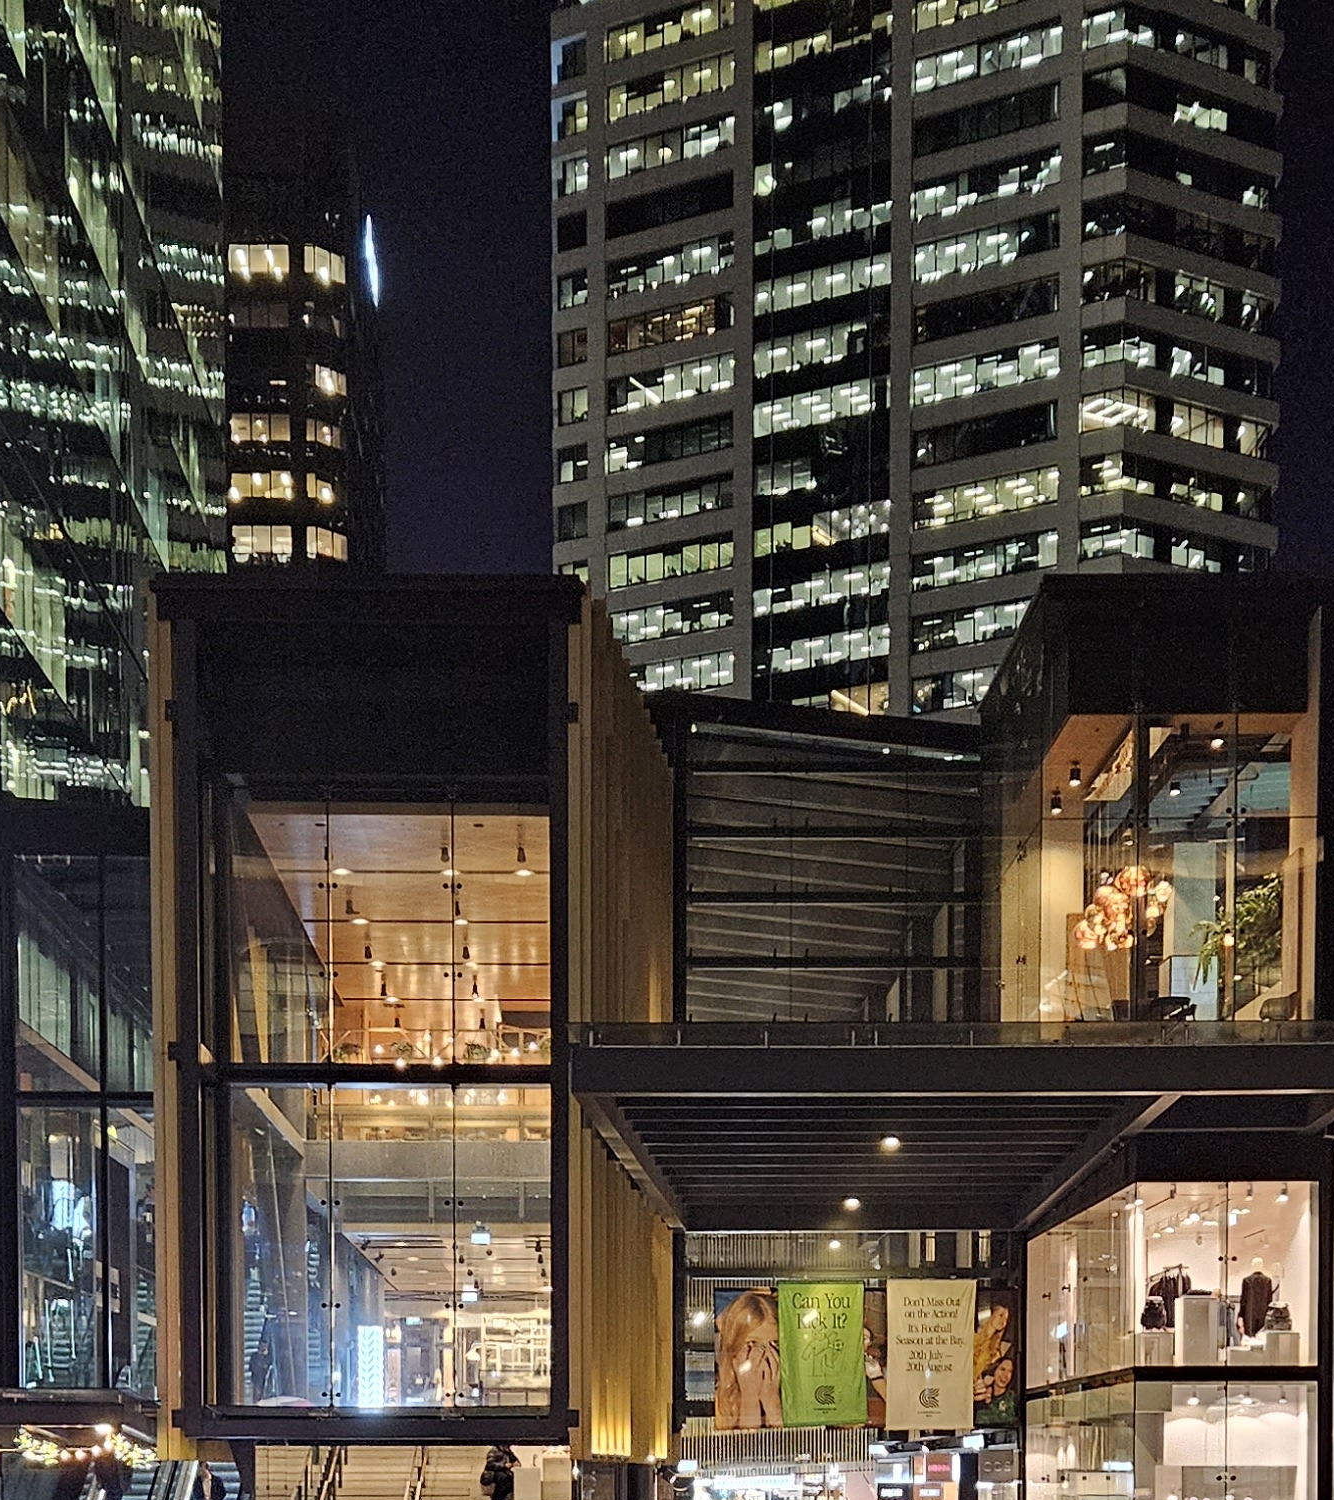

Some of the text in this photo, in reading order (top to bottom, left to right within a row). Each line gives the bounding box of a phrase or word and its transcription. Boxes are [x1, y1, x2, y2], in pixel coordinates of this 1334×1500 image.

[792, 1292, 851, 1309] Can You
[903, 1296, 961, 1307] Don't Miss Out
[904, 1308, 959, 1319] on the Action!
[797, 1311, 848, 1330] Kck It?
[921, 1322, 952, 1333] Football
[896, 1335, 924, 1345] Season
[925, 1336, 934, 1345] at
[935, 1334, 948, 1345] the
[908, 1350, 927, 1360] 20th
[929, 1350, 943, 1362] July
[906, 1361, 952, 1374] 20th August
[983, 1461, 1012, 1473] COS
